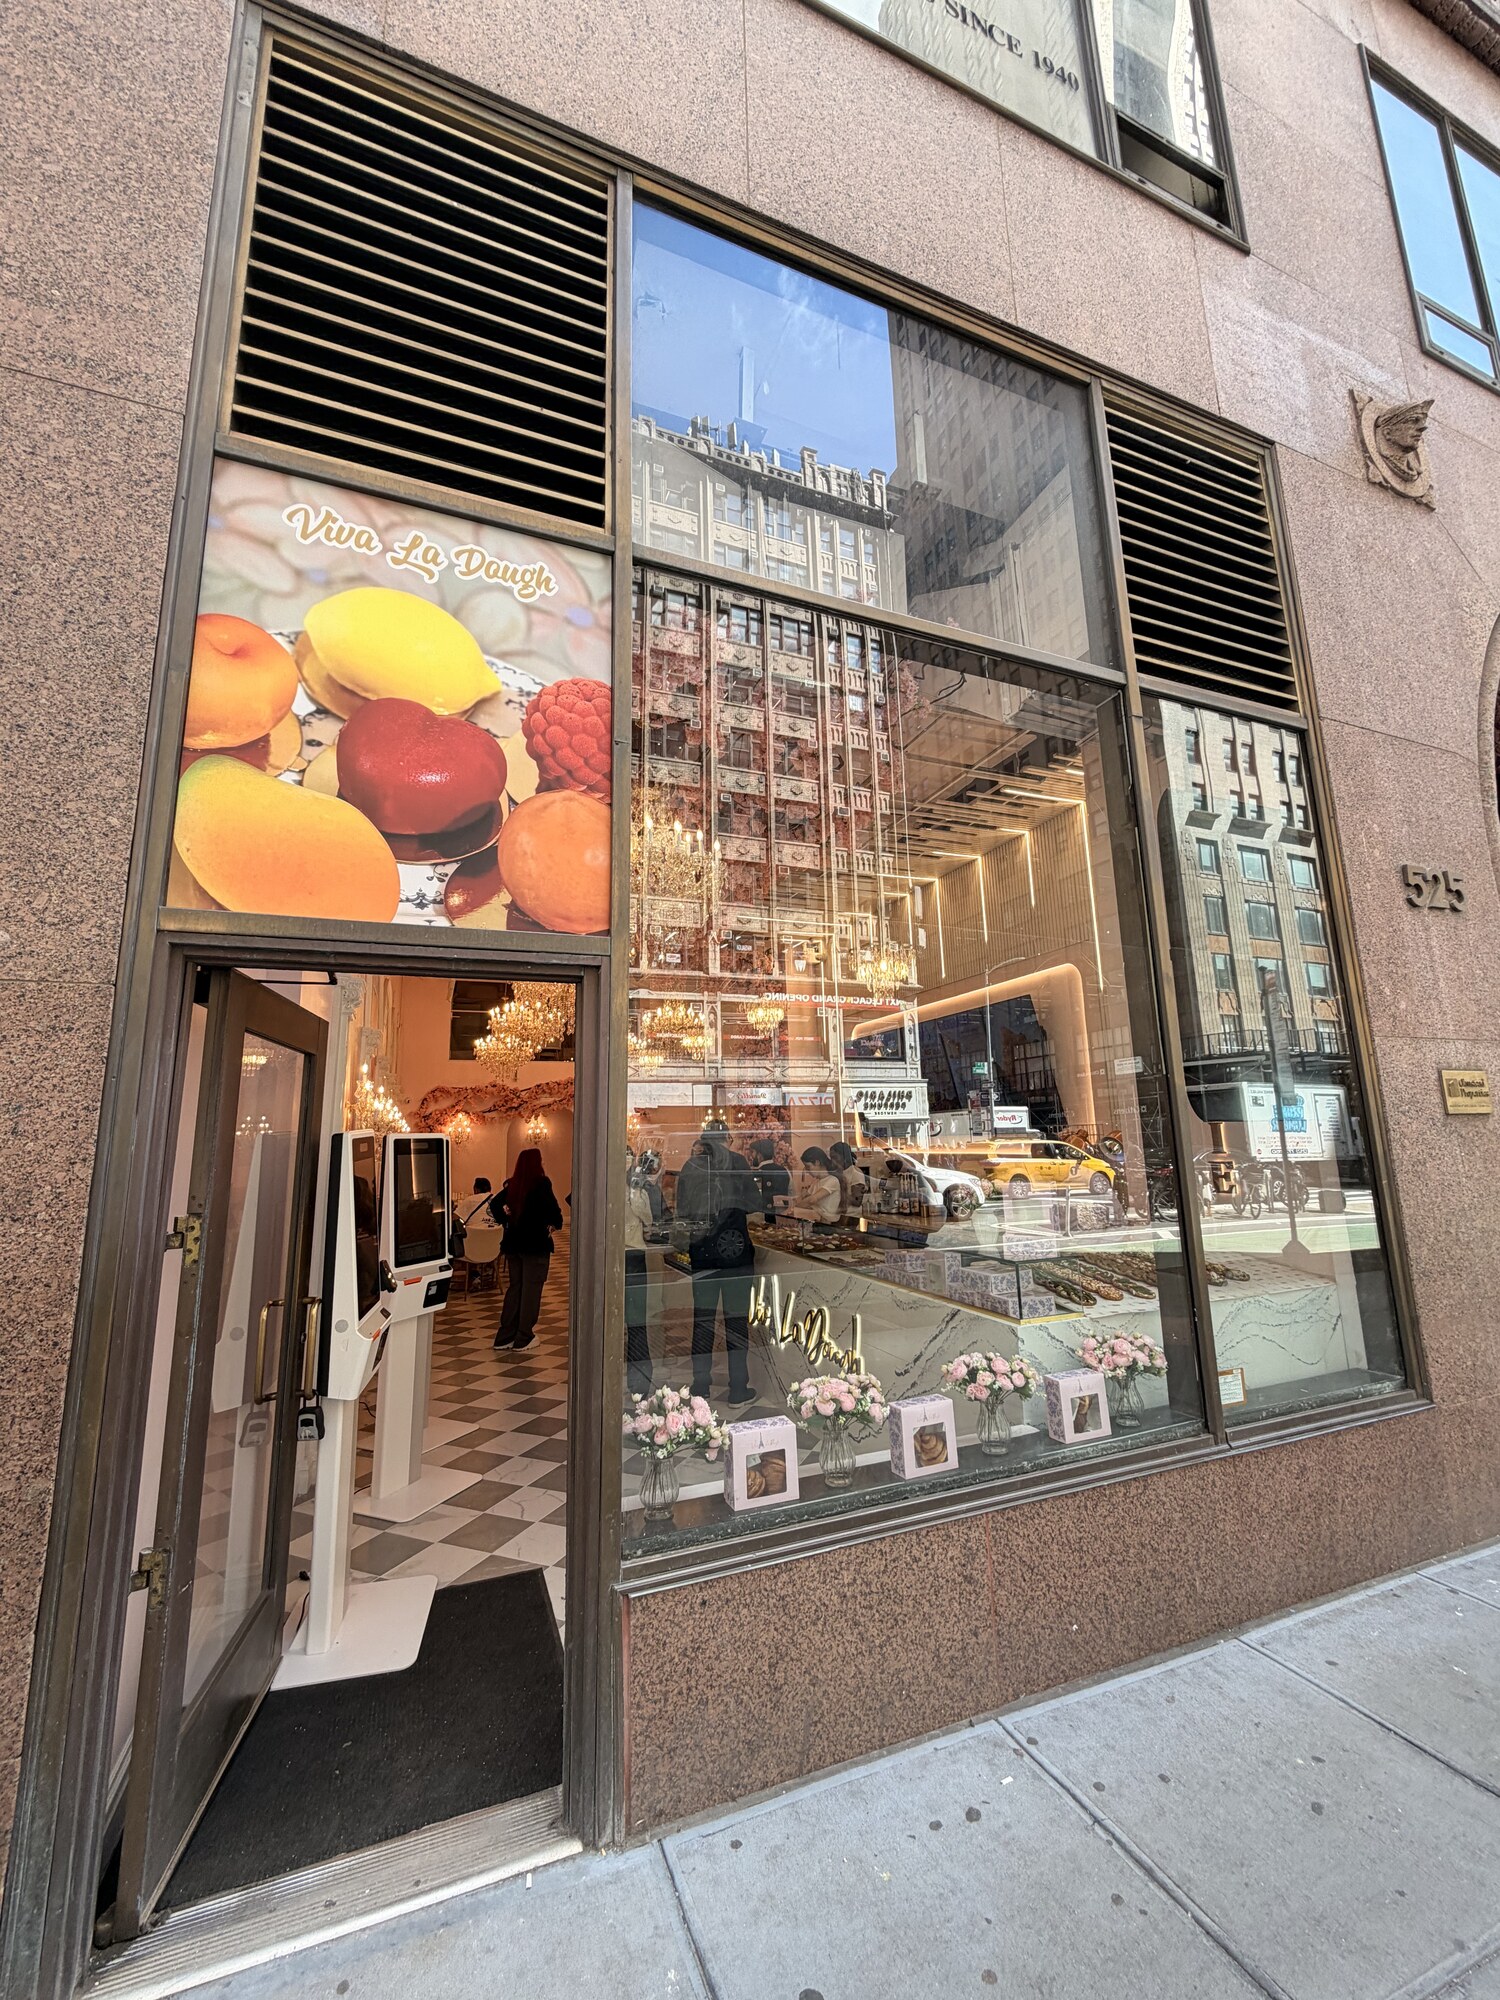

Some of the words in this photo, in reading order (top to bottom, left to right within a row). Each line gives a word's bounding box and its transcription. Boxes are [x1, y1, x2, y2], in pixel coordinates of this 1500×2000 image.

[945, 1, 1023, 58] SINCE
[1032, 50, 1079, 92] 1940
[284, 505, 380, 554] Viva
[388, 532, 444, 582] La
[453, 546, 557, 600] Dough
[1402, 863, 1464, 912] 525
